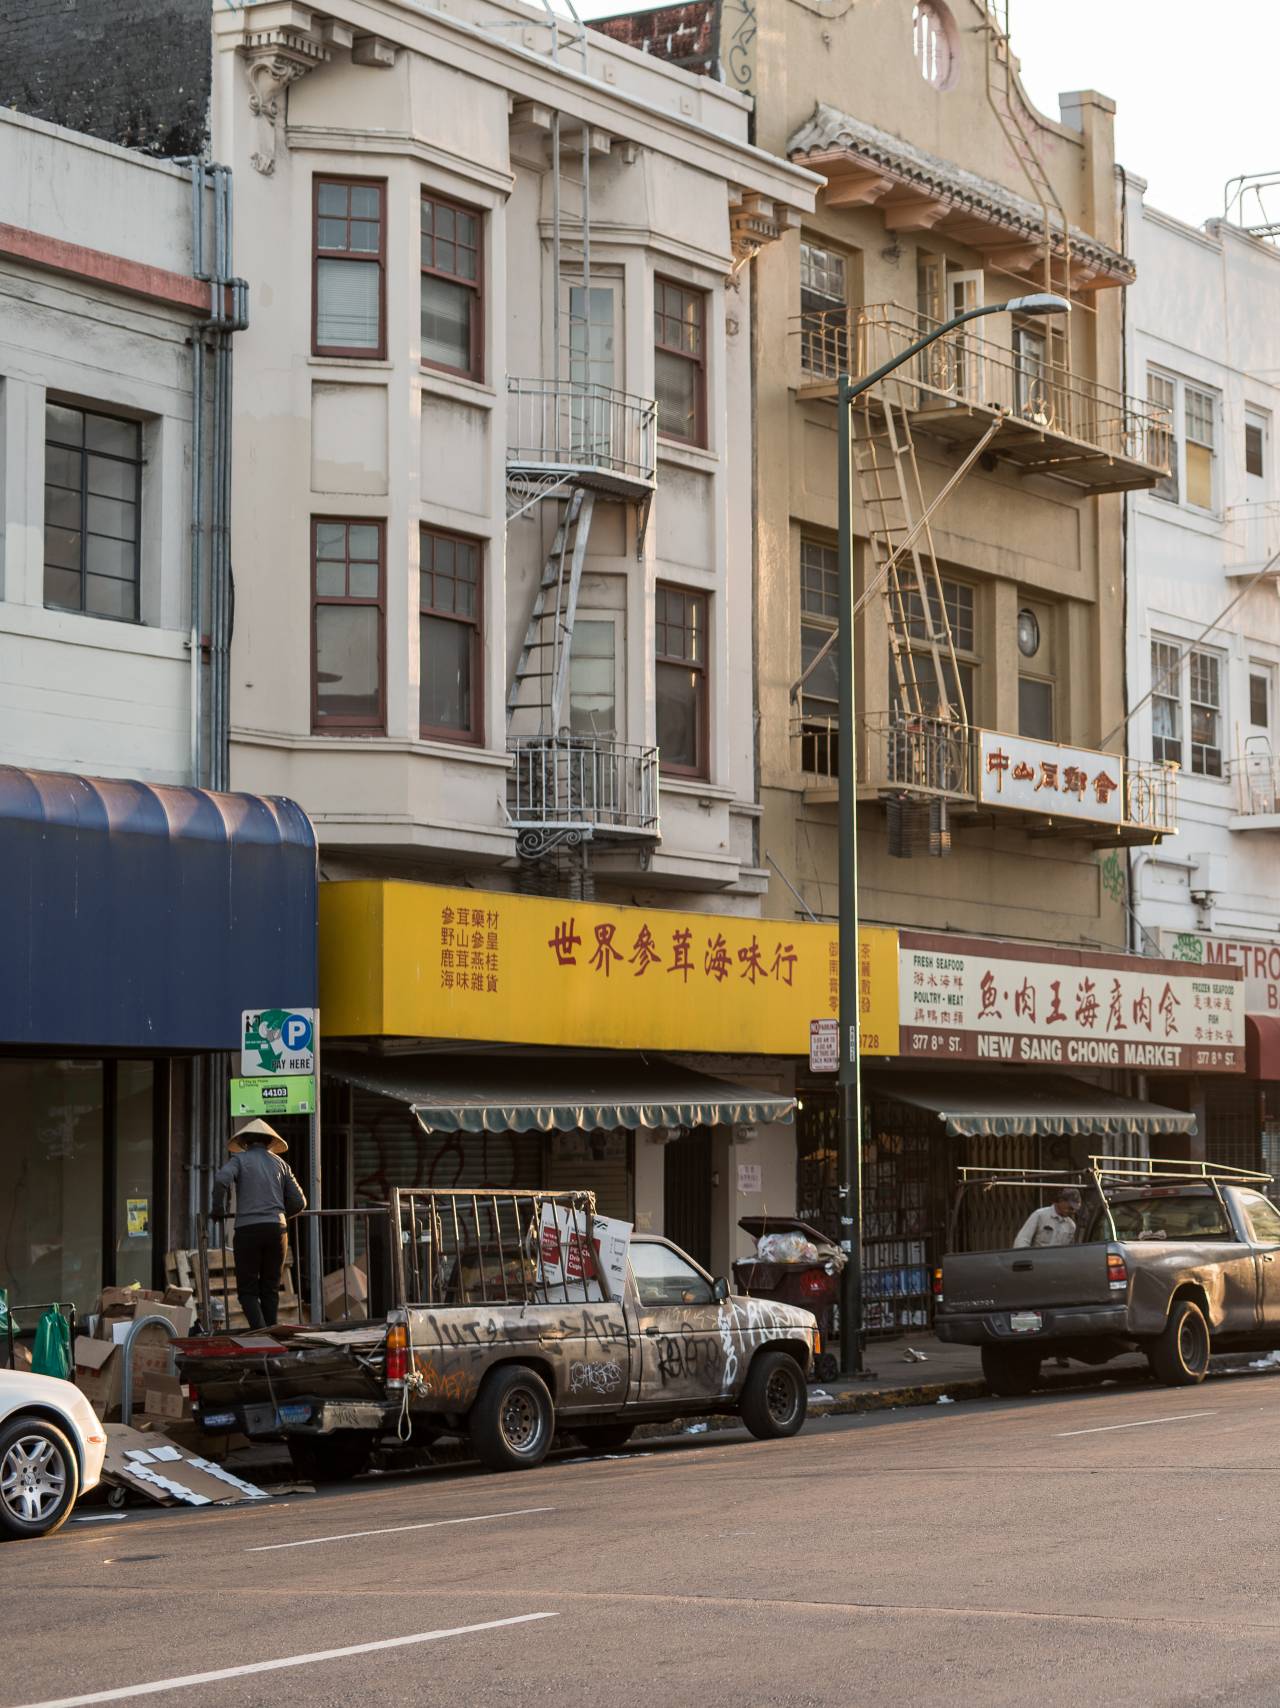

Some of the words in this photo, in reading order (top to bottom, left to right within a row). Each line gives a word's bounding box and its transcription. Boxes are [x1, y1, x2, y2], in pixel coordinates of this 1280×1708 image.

[913, 954, 934, 968] FRESH
[936, 957, 964, 971] SEAFOOD
[1192, 982, 1210, 993] FROZEN
[1212, 984, 1234, 996] SEAFOOD
[913, 991, 942, 1005] POULTRY
[947, 995, 964, 1006] MEAT
[288, 1021, 306, 1047] P
[912, 1033, 929, 1050] 377
[931, 1035, 944, 1051] 8th
[948, 1036, 963, 1052] ST.
[977, 1034, 1014, 1059] NEW
[1020, 1037, 1062, 1062] SANG
[1067, 1040, 1119, 1065] CHONG
[1124, 1044, 1182, 1067] MARKET
[1197, 1051, 1210, 1065] 377
[271, 1059, 286, 1070] PAY
[289, 1058, 311, 1070] HERE
[262, 1088, 287, 1097] 44103
